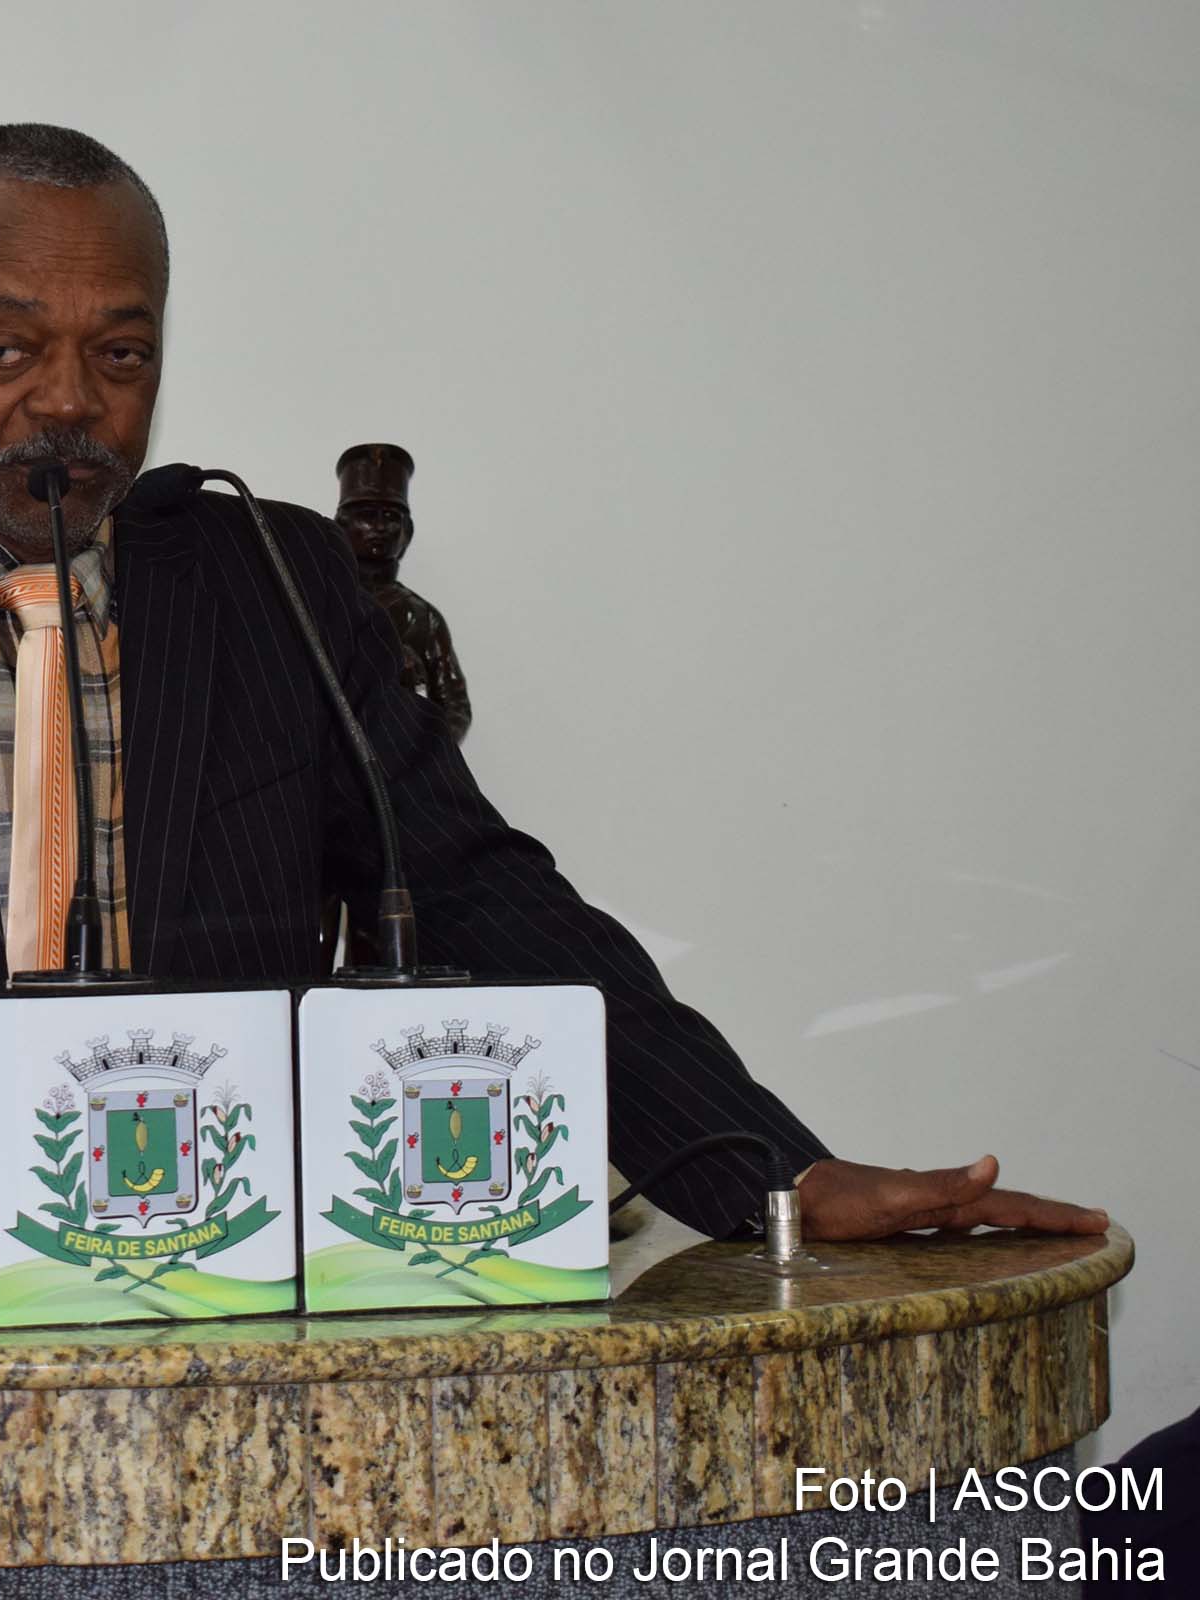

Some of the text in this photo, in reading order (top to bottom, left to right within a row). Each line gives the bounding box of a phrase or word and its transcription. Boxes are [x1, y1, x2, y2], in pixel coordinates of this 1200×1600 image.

[64, 1222, 222, 1256] FEIRA DE SANTANA
[379, 1211, 535, 1241] FEIRA DE SANTANA
